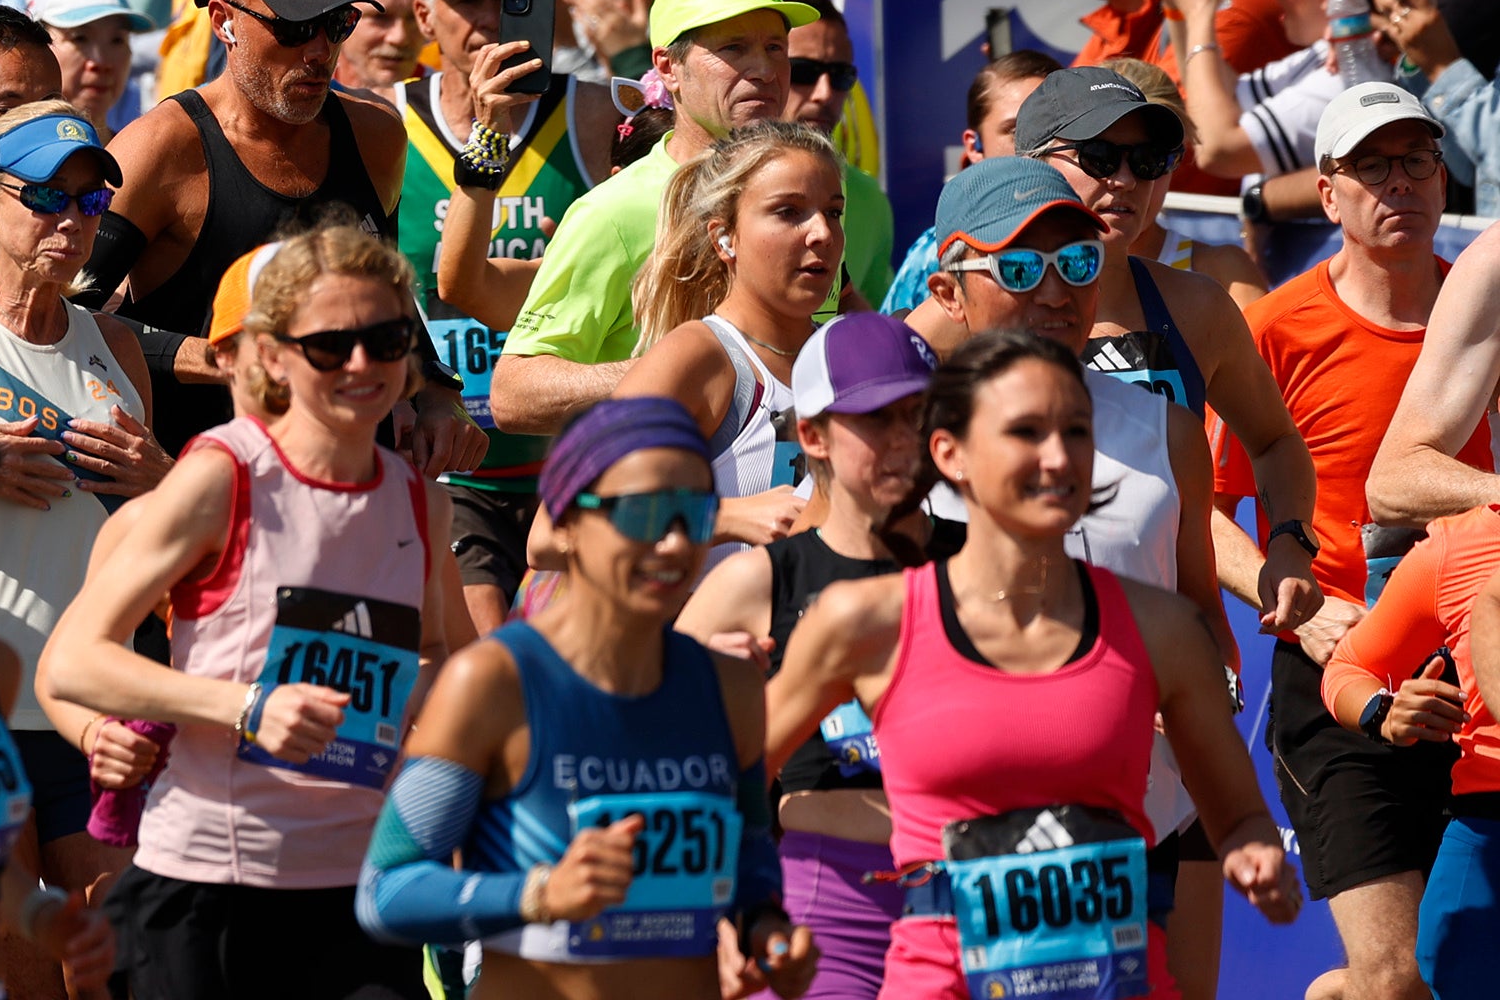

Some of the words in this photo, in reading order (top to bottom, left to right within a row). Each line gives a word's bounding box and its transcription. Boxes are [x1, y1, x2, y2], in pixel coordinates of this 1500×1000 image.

[433, 196, 546, 233] STH
[443, 327, 507, 375] 165
[86, 379, 121, 401] 24
[276, 639, 400, 719] 16451
[831, 719, 838, 734] 1
[552, 752, 731, 792] ECUADOR
[596, 808, 726, 878] 251
[973, 855, 1133, 940] 16035
